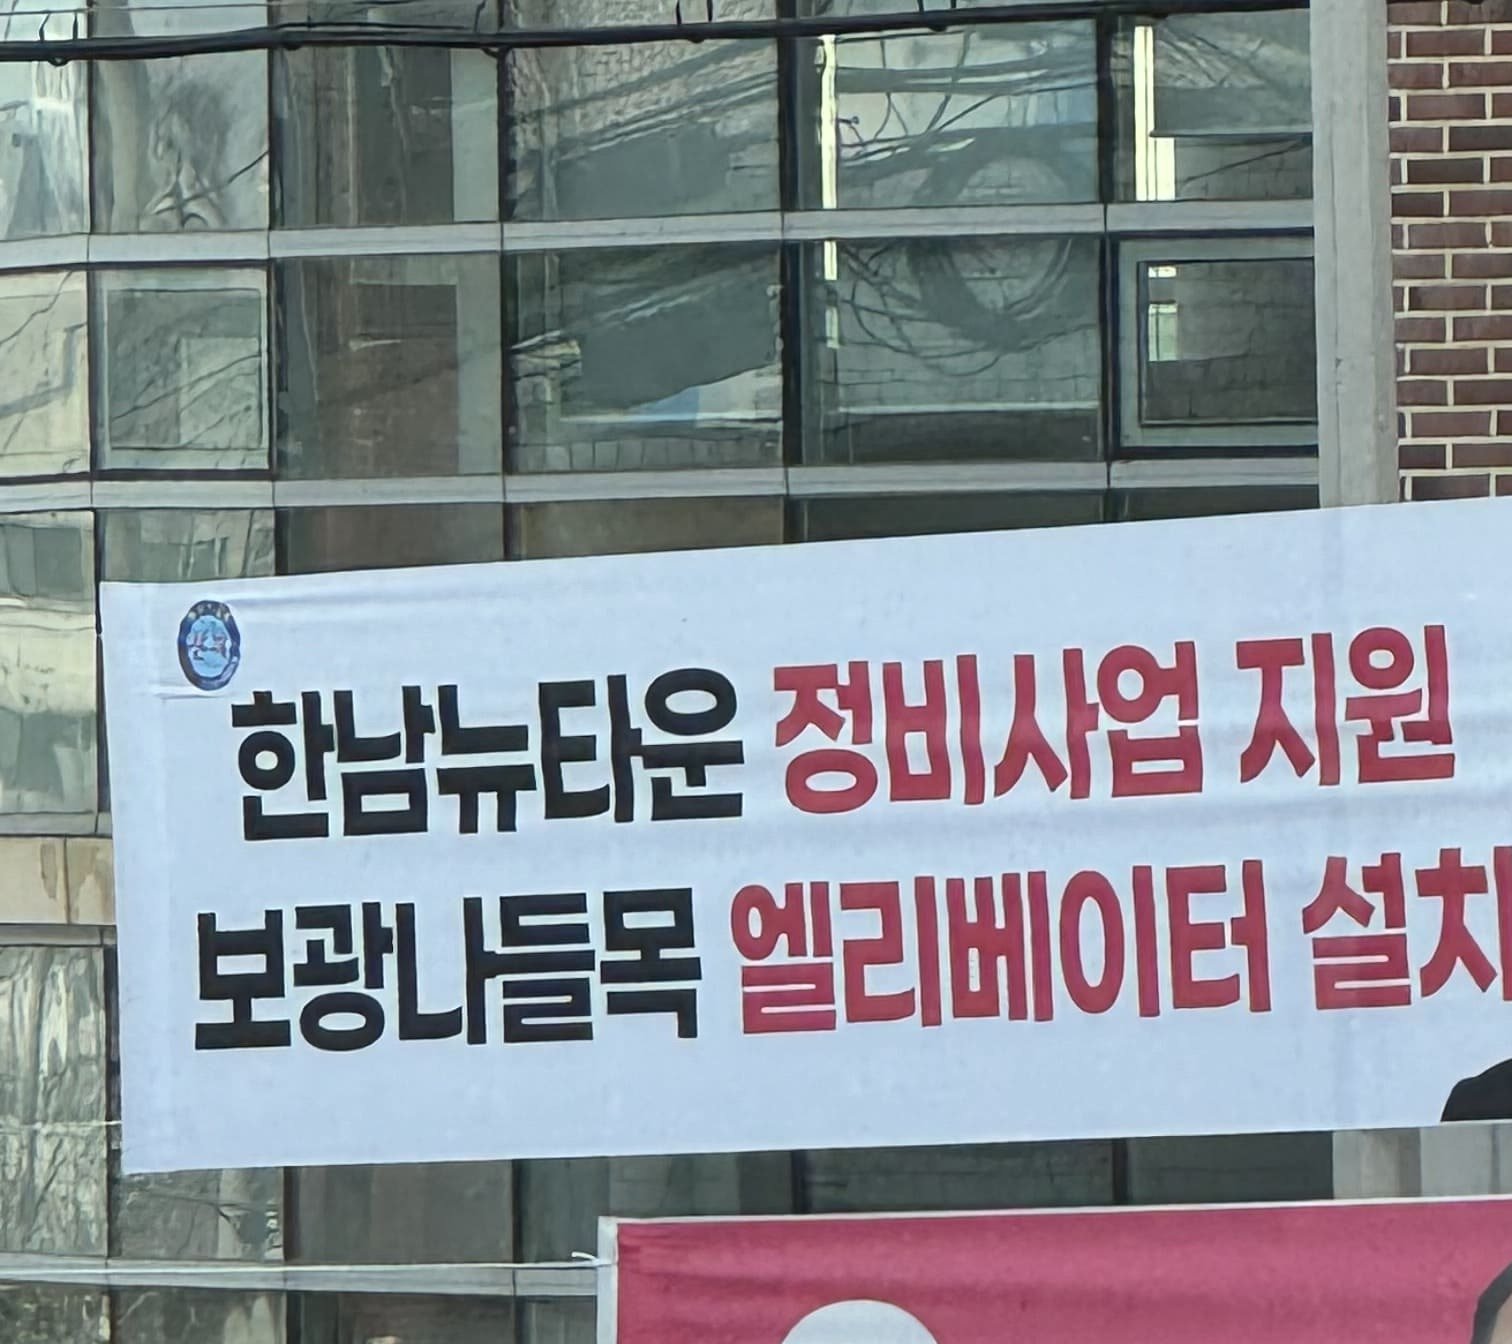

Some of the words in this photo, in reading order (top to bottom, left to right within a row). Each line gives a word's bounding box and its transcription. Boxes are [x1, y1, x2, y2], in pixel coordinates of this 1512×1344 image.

[231, 667, 744, 841] 한남뉴타운
[772, 640, 1202, 815] 정비사업
[1237, 626, 1456, 788] 지원
[193, 887, 703, 1052] 보광나들목
[731, 860, 1270, 1037] 엘리베이터
